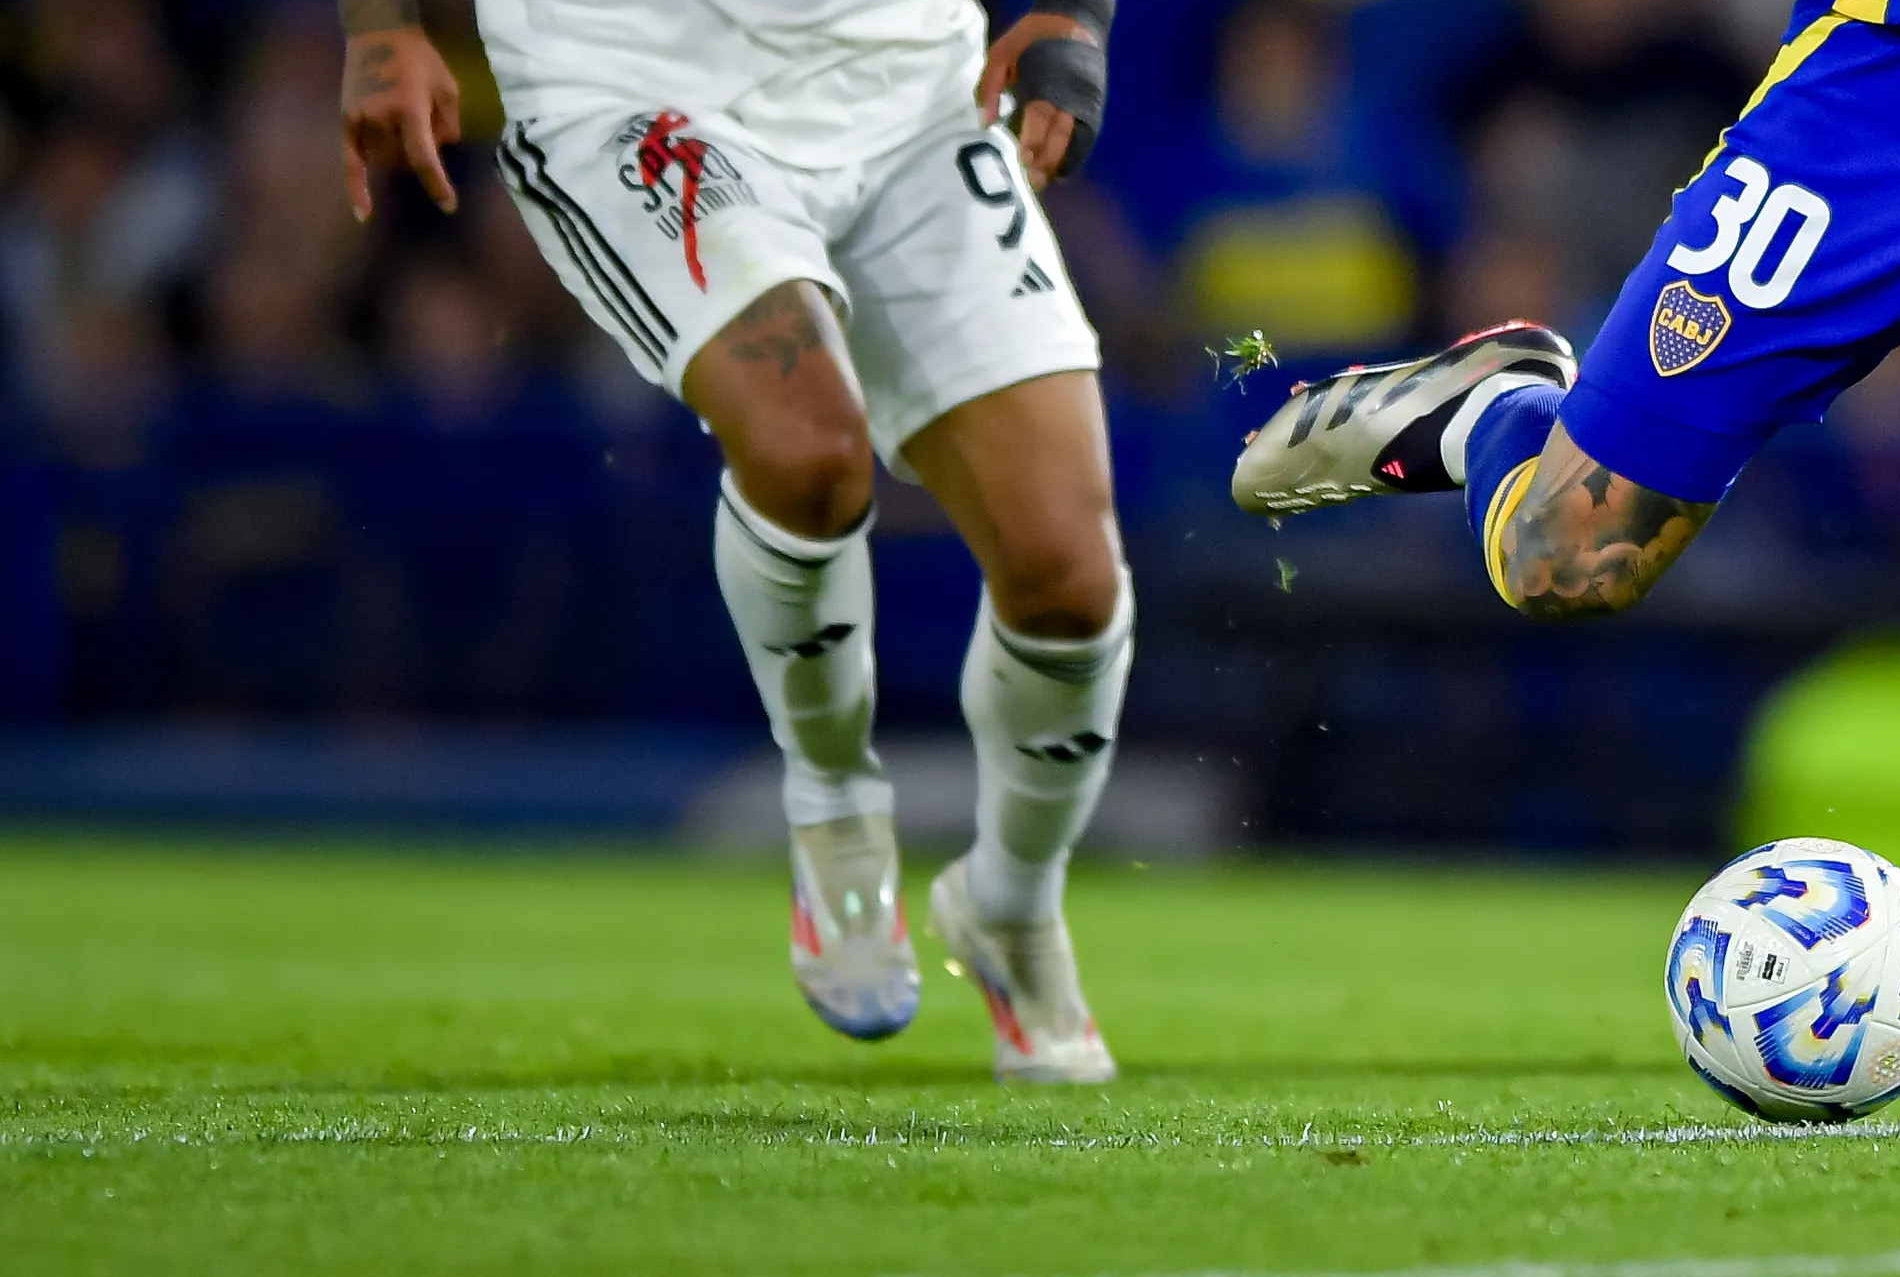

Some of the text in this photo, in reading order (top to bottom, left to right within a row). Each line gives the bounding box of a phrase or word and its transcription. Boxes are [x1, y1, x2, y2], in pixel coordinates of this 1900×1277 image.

[954, 141, 1028, 251] 9
[1666, 156, 1831, 310] 30
[1658, 307, 1713, 345] CABJ
